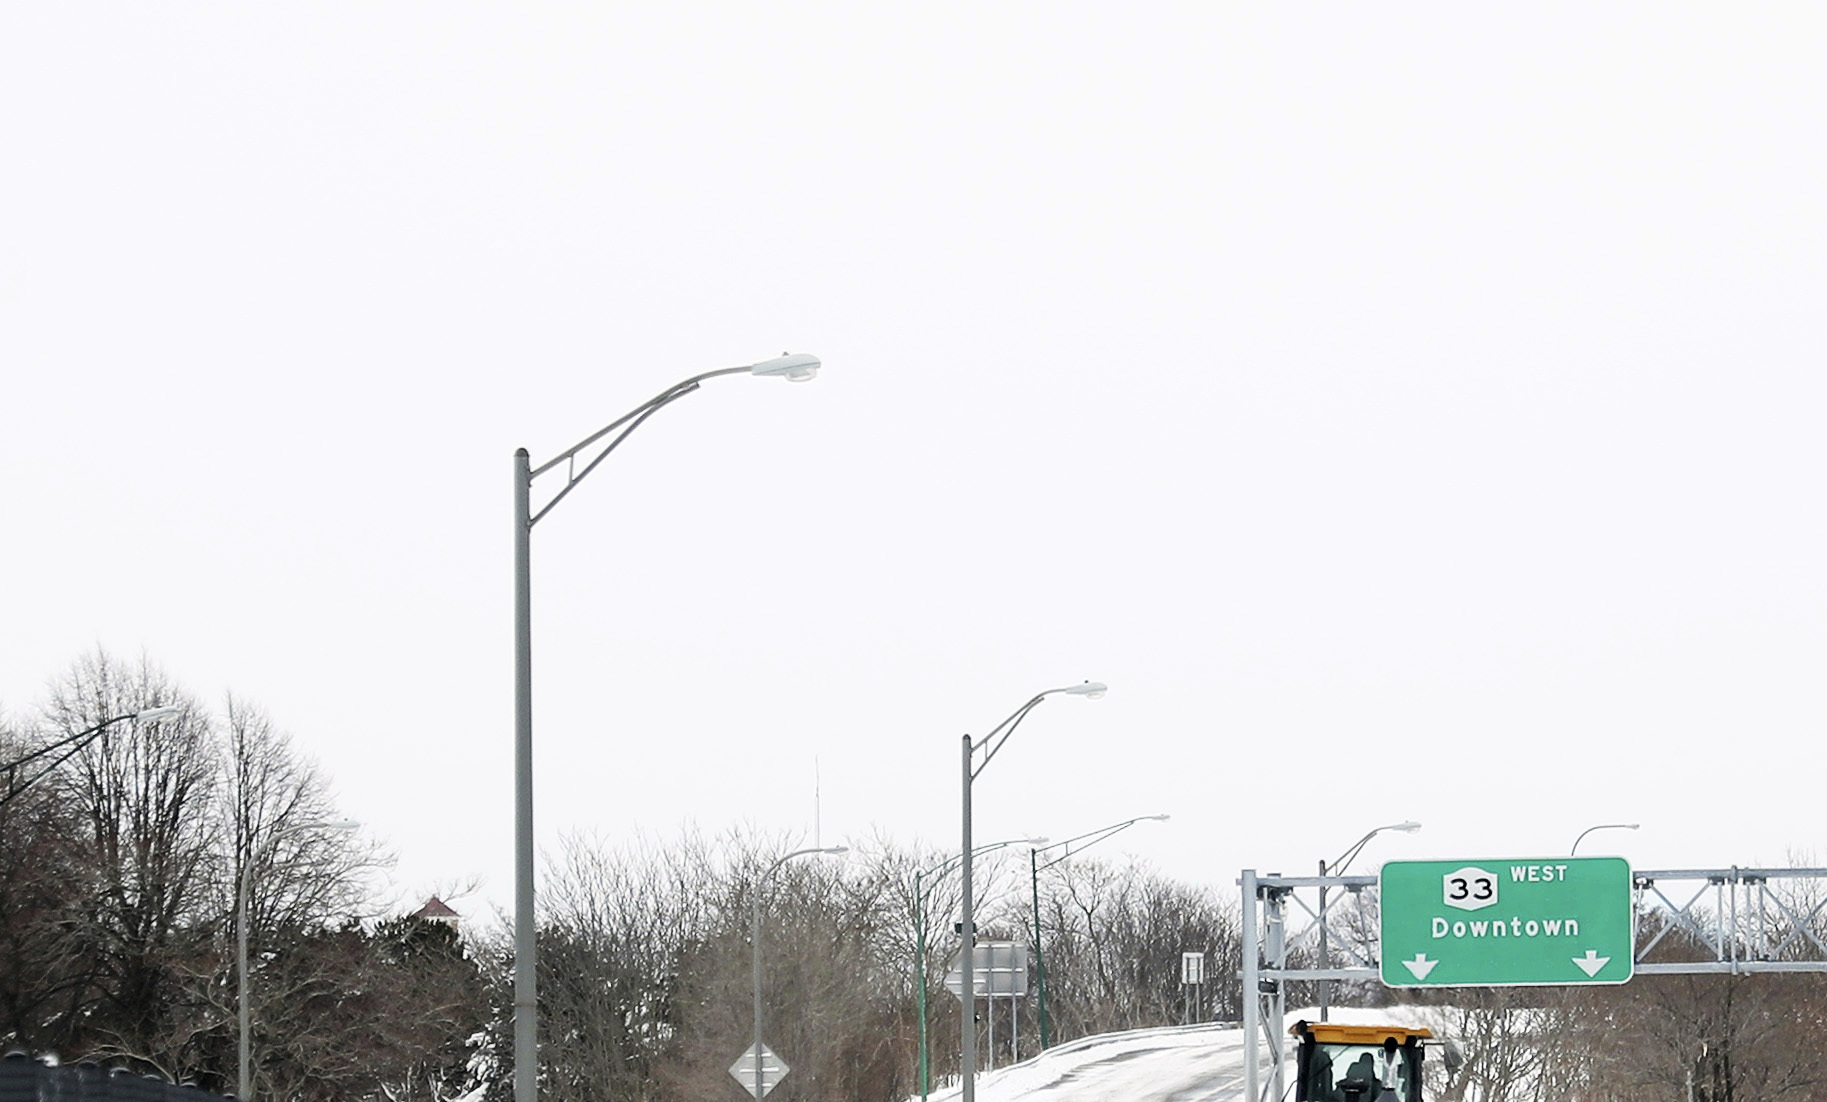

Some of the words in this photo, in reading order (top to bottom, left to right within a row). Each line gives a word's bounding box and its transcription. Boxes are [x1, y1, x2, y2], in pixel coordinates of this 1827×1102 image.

[1510, 865, 1568, 882] WEST
[1450, 879, 1493, 900] 33
[1432, 917, 1579, 938] Downtown
